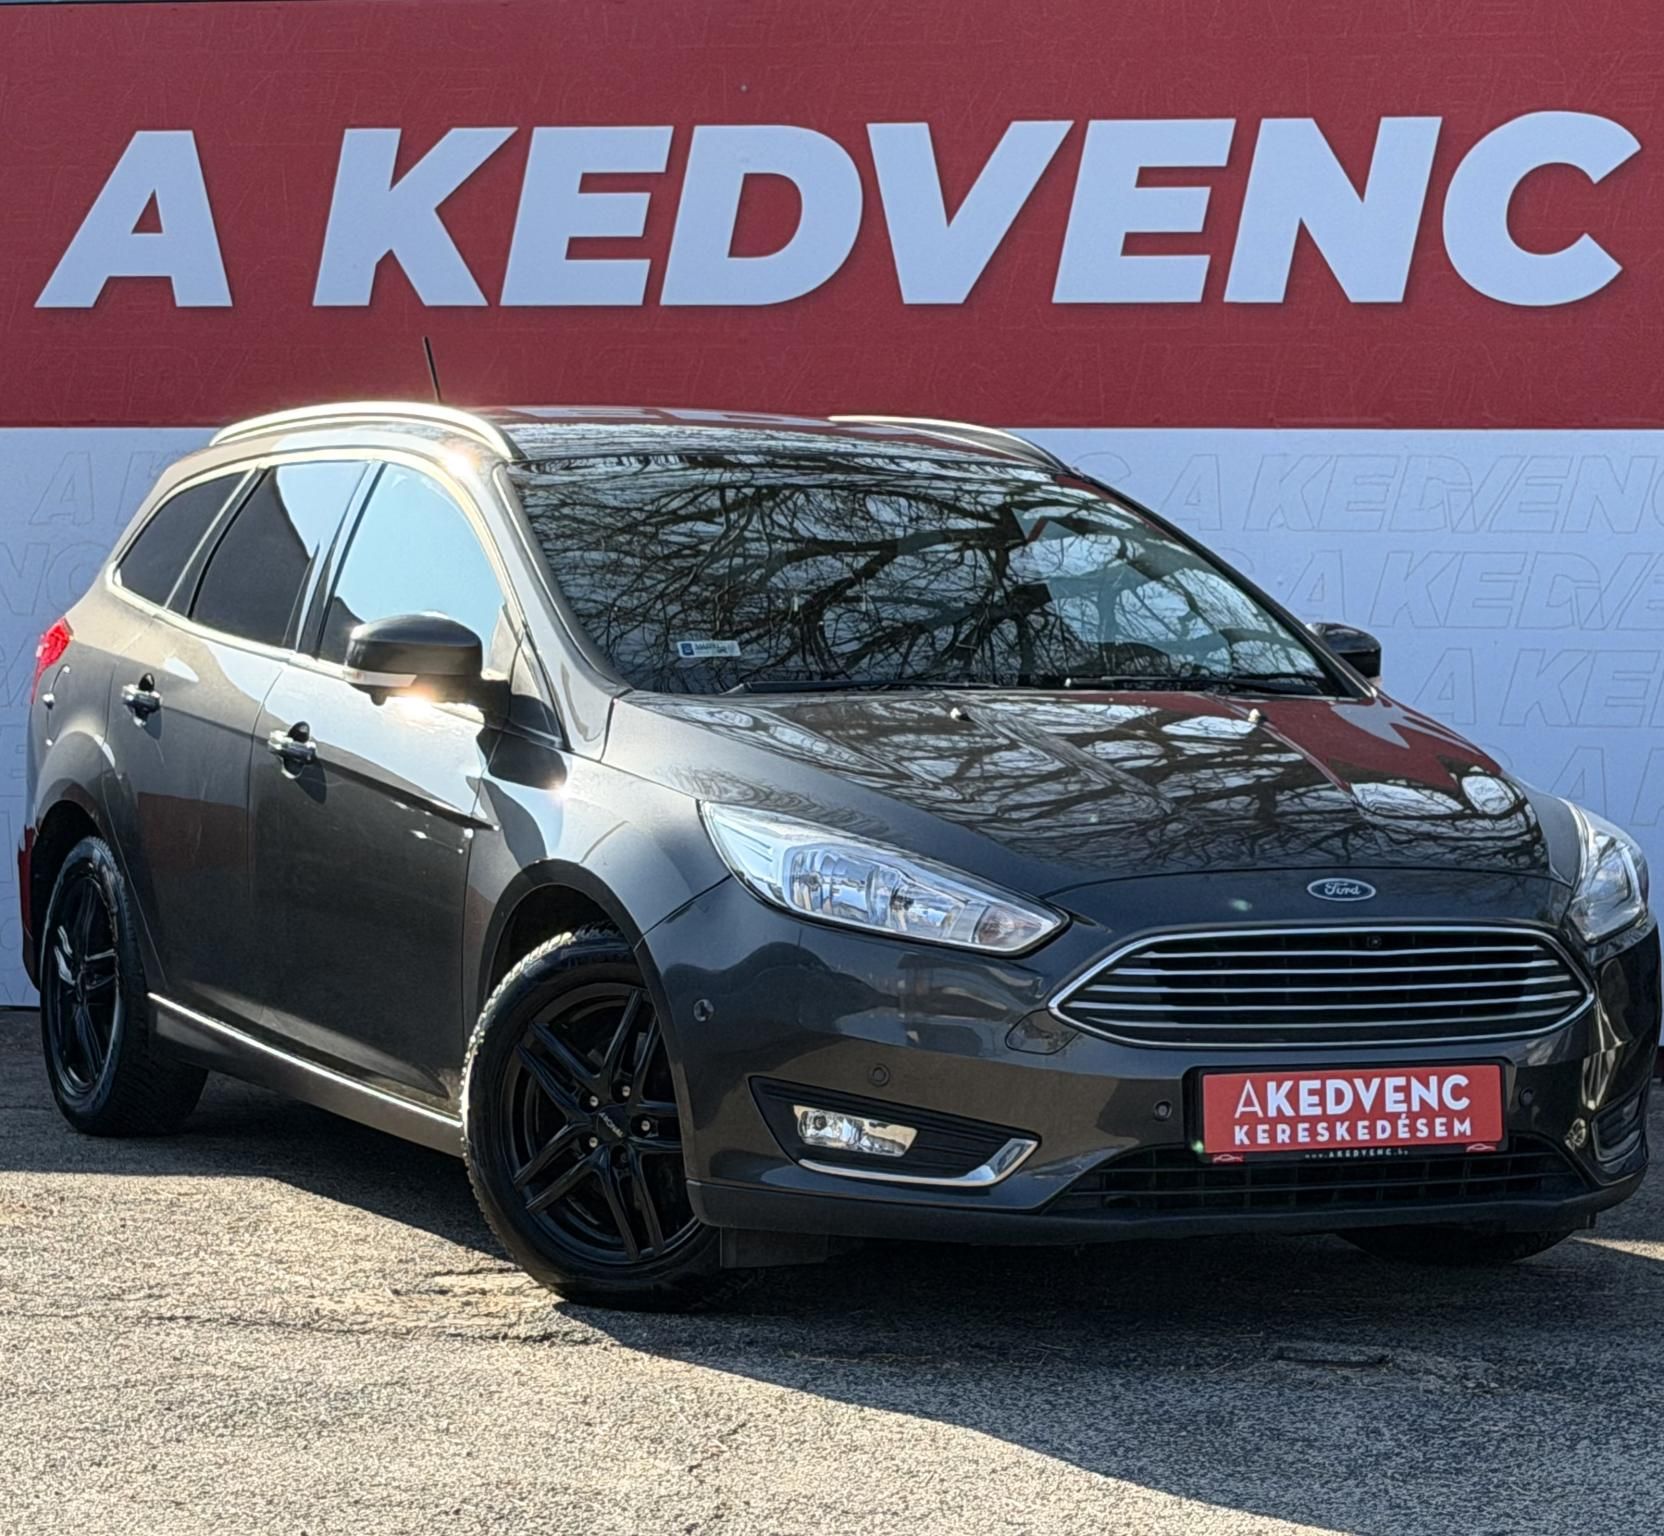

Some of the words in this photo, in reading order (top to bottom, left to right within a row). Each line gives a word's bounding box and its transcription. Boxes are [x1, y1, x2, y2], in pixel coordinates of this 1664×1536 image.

[35, 130, 232, 309] A
[312, 110, 1641, 308] KEDVENC
[1324, 881, 1361, 896] Ford
[1234, 1114, 1472, 1145] KERESKEDÉSEM
